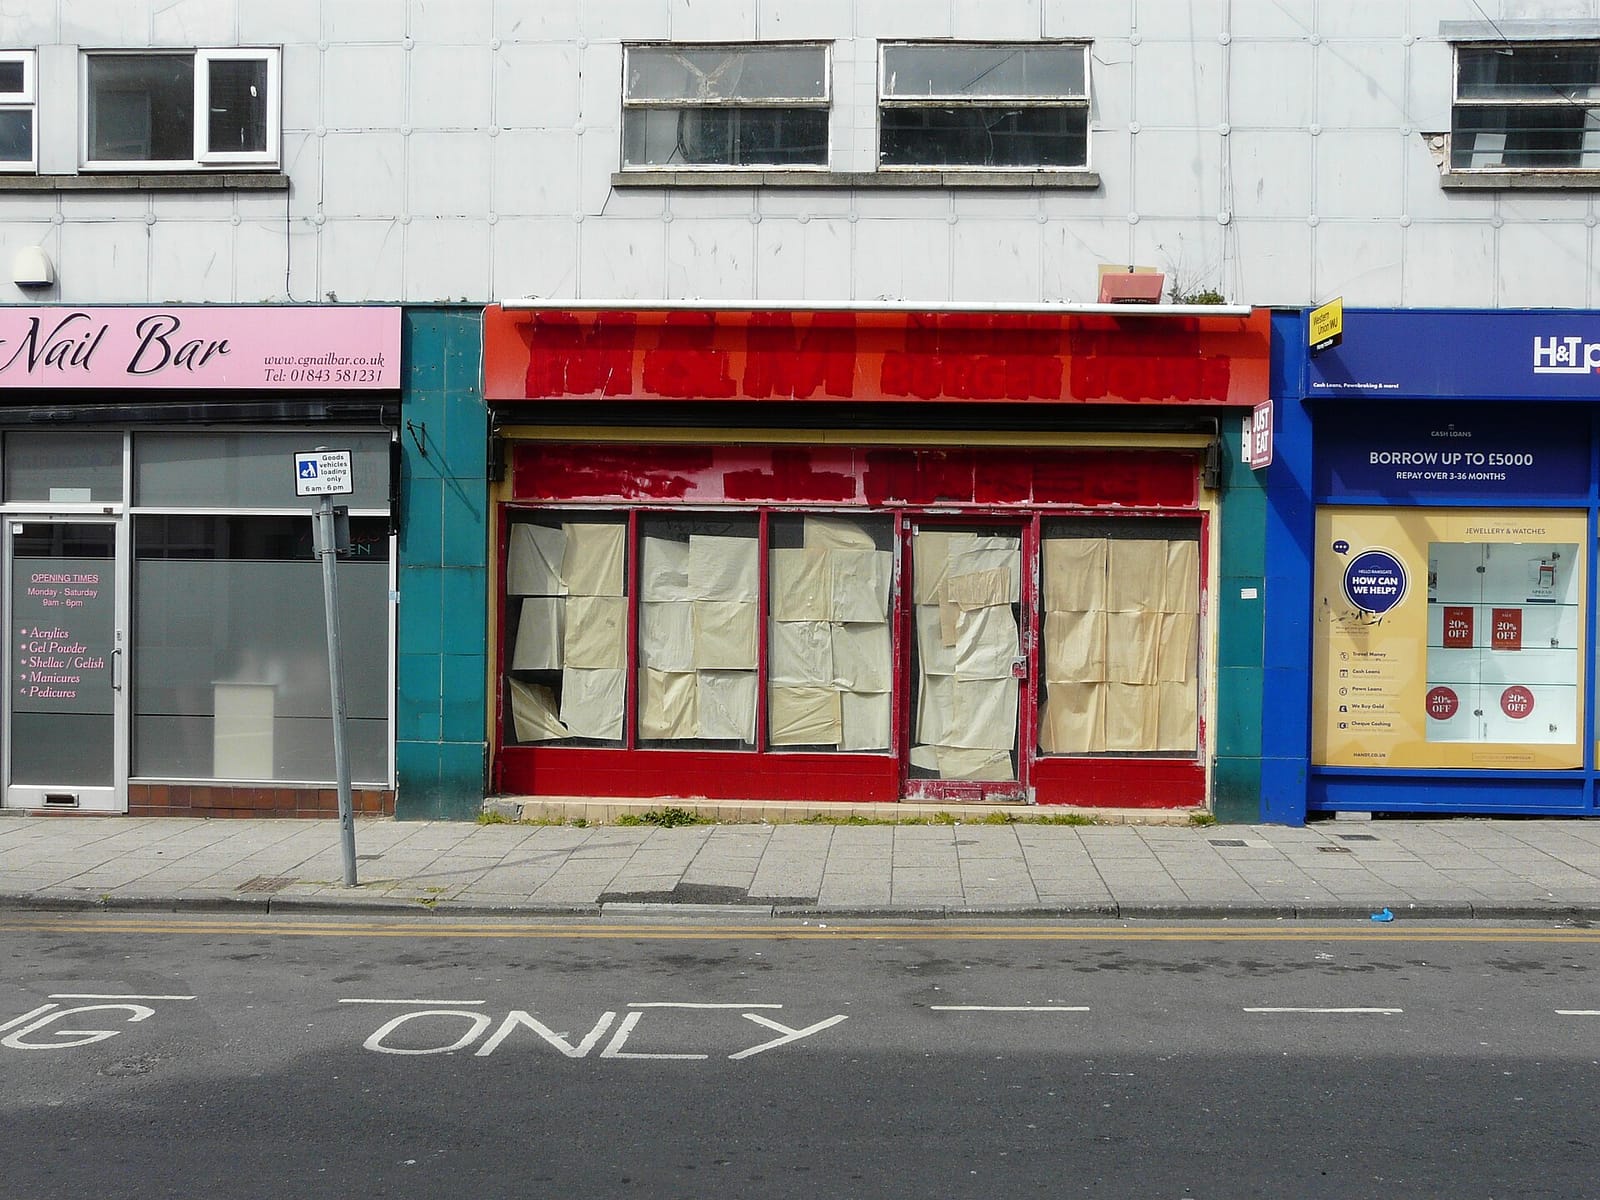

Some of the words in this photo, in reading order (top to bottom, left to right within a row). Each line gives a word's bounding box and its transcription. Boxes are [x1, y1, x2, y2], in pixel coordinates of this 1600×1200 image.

[0, 313, 109, 373] Nail
[126, 314, 230, 373] Bar
[264, 352, 385, 367] www.cgnailbar.co.uk
[264, 369, 287, 381] Tel:
[291, 369, 330, 382] 01843
[335, 370, 382, 382] 581231
[1253, 407, 1269, 432] JUST
[1257, 430, 1269, 454] EAT
[1369, 452, 1438, 465] BORROW
[1441, 452, 1462, 465] UP
[1465, 453, 1485, 465] TO
[1488, 453, 1533, 466] £5000
[1396, 472, 1423, 480] REPAY
[1424, 472, 1448, 480] OVER
[1468, 473, 1506, 481] MONTHS
[31, 574, 71, 583] OPENING
[73, 574, 99, 583] TIMES
[1352, 576, 1377, 585] HOW
[1378, 577, 1398, 585] CAN
[27, 588, 57, 597] Monday
[64, 588, 98, 598] Saturday
[1353, 586, 1368, 594] WE
[1369, 586, 1397, 595] HELP?
[65, 599, 83, 608] 6pm
[1449, 620, 1468, 629] 20%
[1497, 622, 1517, 631] 20%
[29, 627, 69, 639] Acrylics
[1448, 629, 1469, 638] OFF
[1496, 631, 1517, 640] OFF
[29, 641, 46, 653] Gel
[49, 641, 87, 654] Powder
[29, 656, 64, 668] Shellac
[74, 656, 104, 668] Gelish
[29, 671, 80, 683] Manicures
[29, 686, 76, 698] Pedicures
[1432, 695, 1452, 704] 20%
[1508, 694, 1527, 703] 20%
[1432, 704, 1452, 713] OFF
[1507, 702, 1528, 712] OFF
[362, 1009, 849, 1061] ONLY
